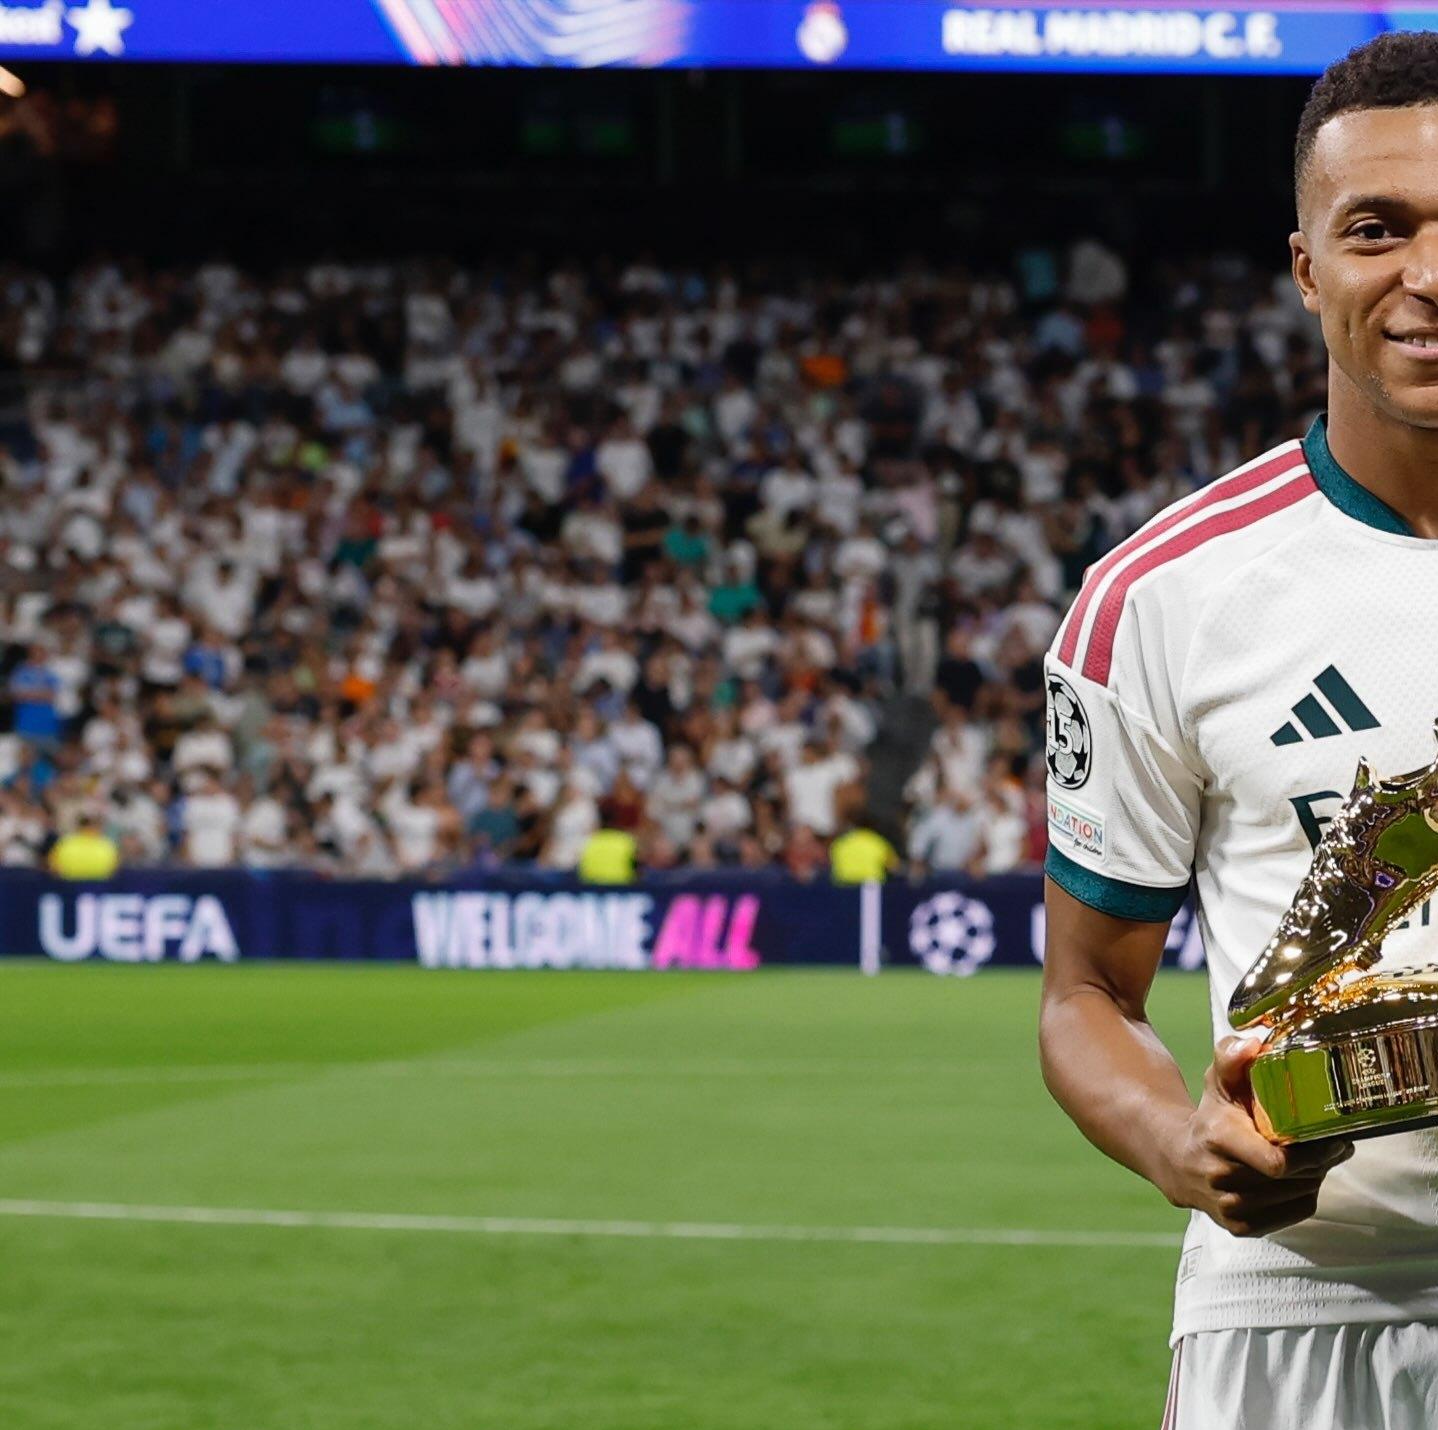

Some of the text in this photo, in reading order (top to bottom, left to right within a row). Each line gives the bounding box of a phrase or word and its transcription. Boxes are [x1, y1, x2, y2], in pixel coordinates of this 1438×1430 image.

[38, 892, 241, 963] UEFA
[411, 890, 760, 971] WELCOME ALL
